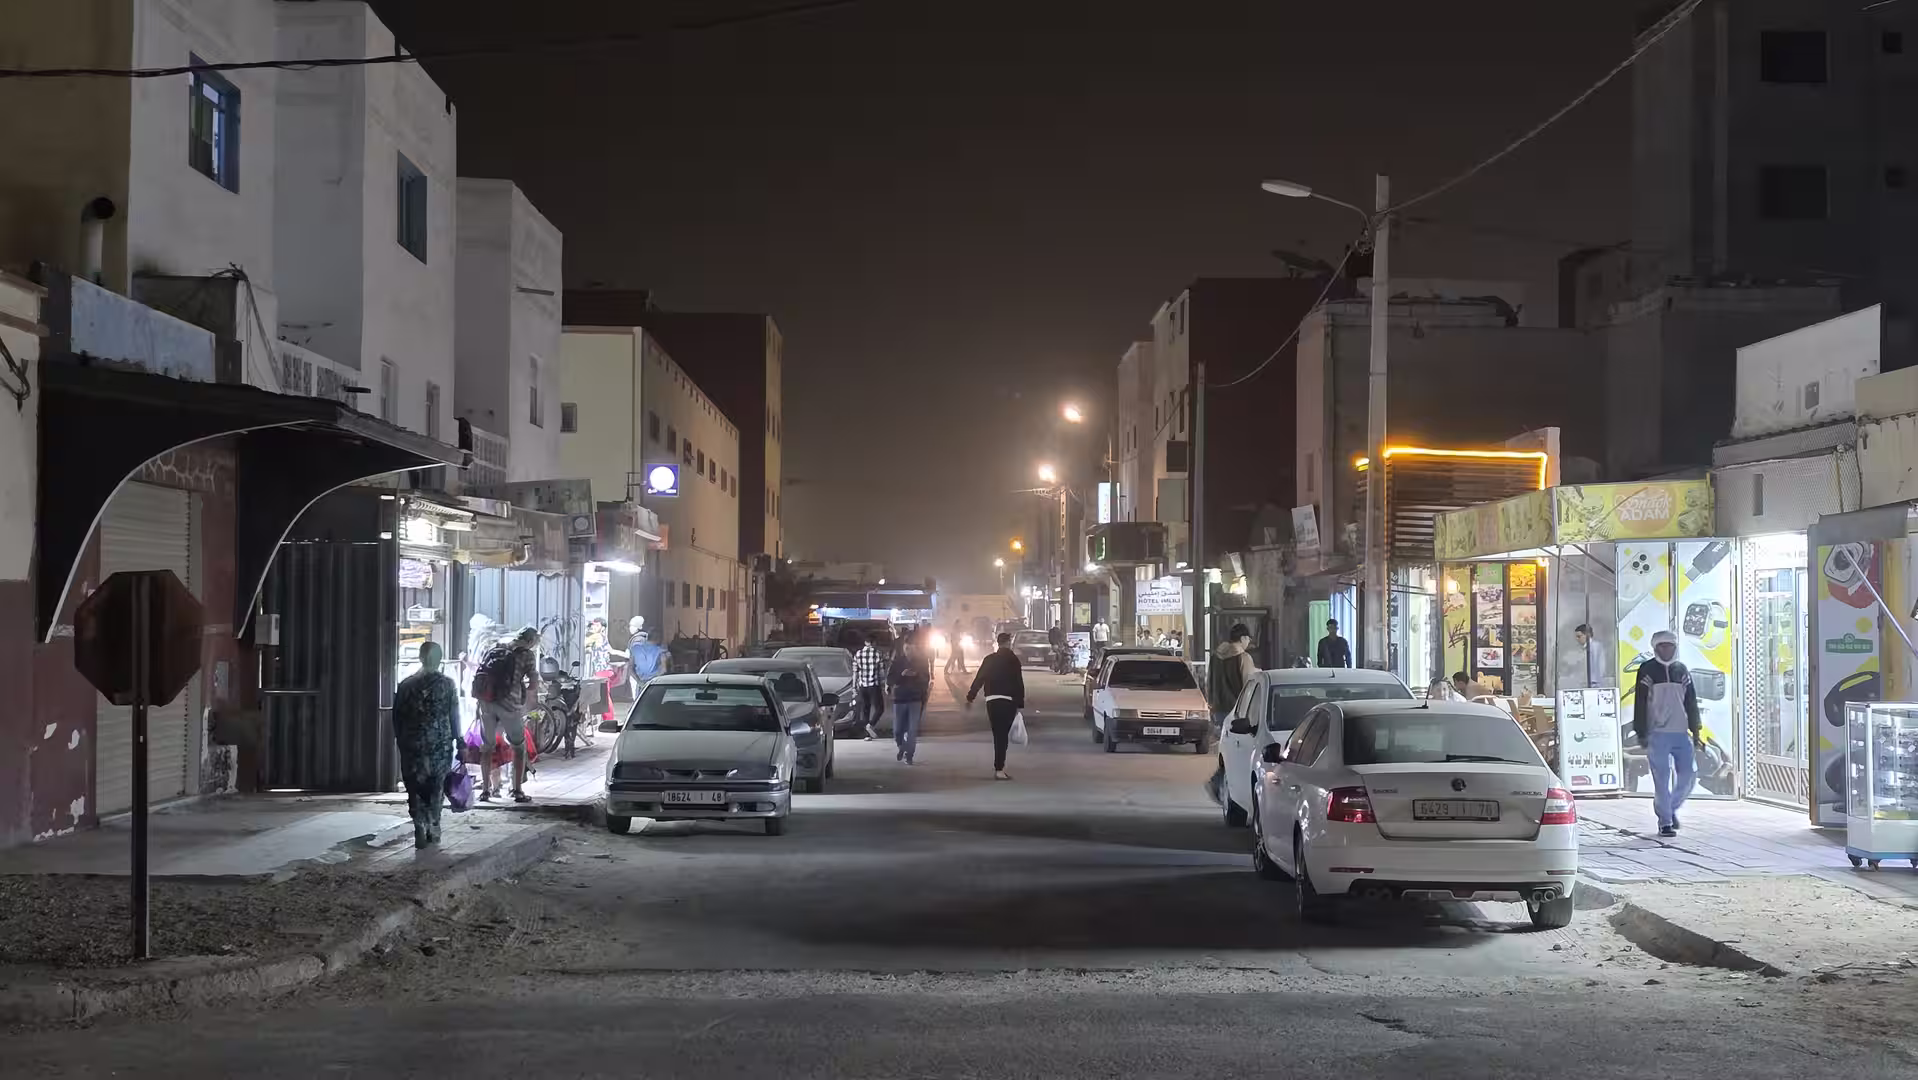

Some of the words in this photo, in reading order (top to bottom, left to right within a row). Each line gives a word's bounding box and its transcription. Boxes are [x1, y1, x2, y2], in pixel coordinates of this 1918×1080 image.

[1621, 508, 1669, 521] ADAM
[667, 792, 691, 802] 18624
[711, 792, 722, 802] 48
[1420, 802, 1449, 817] 6429
